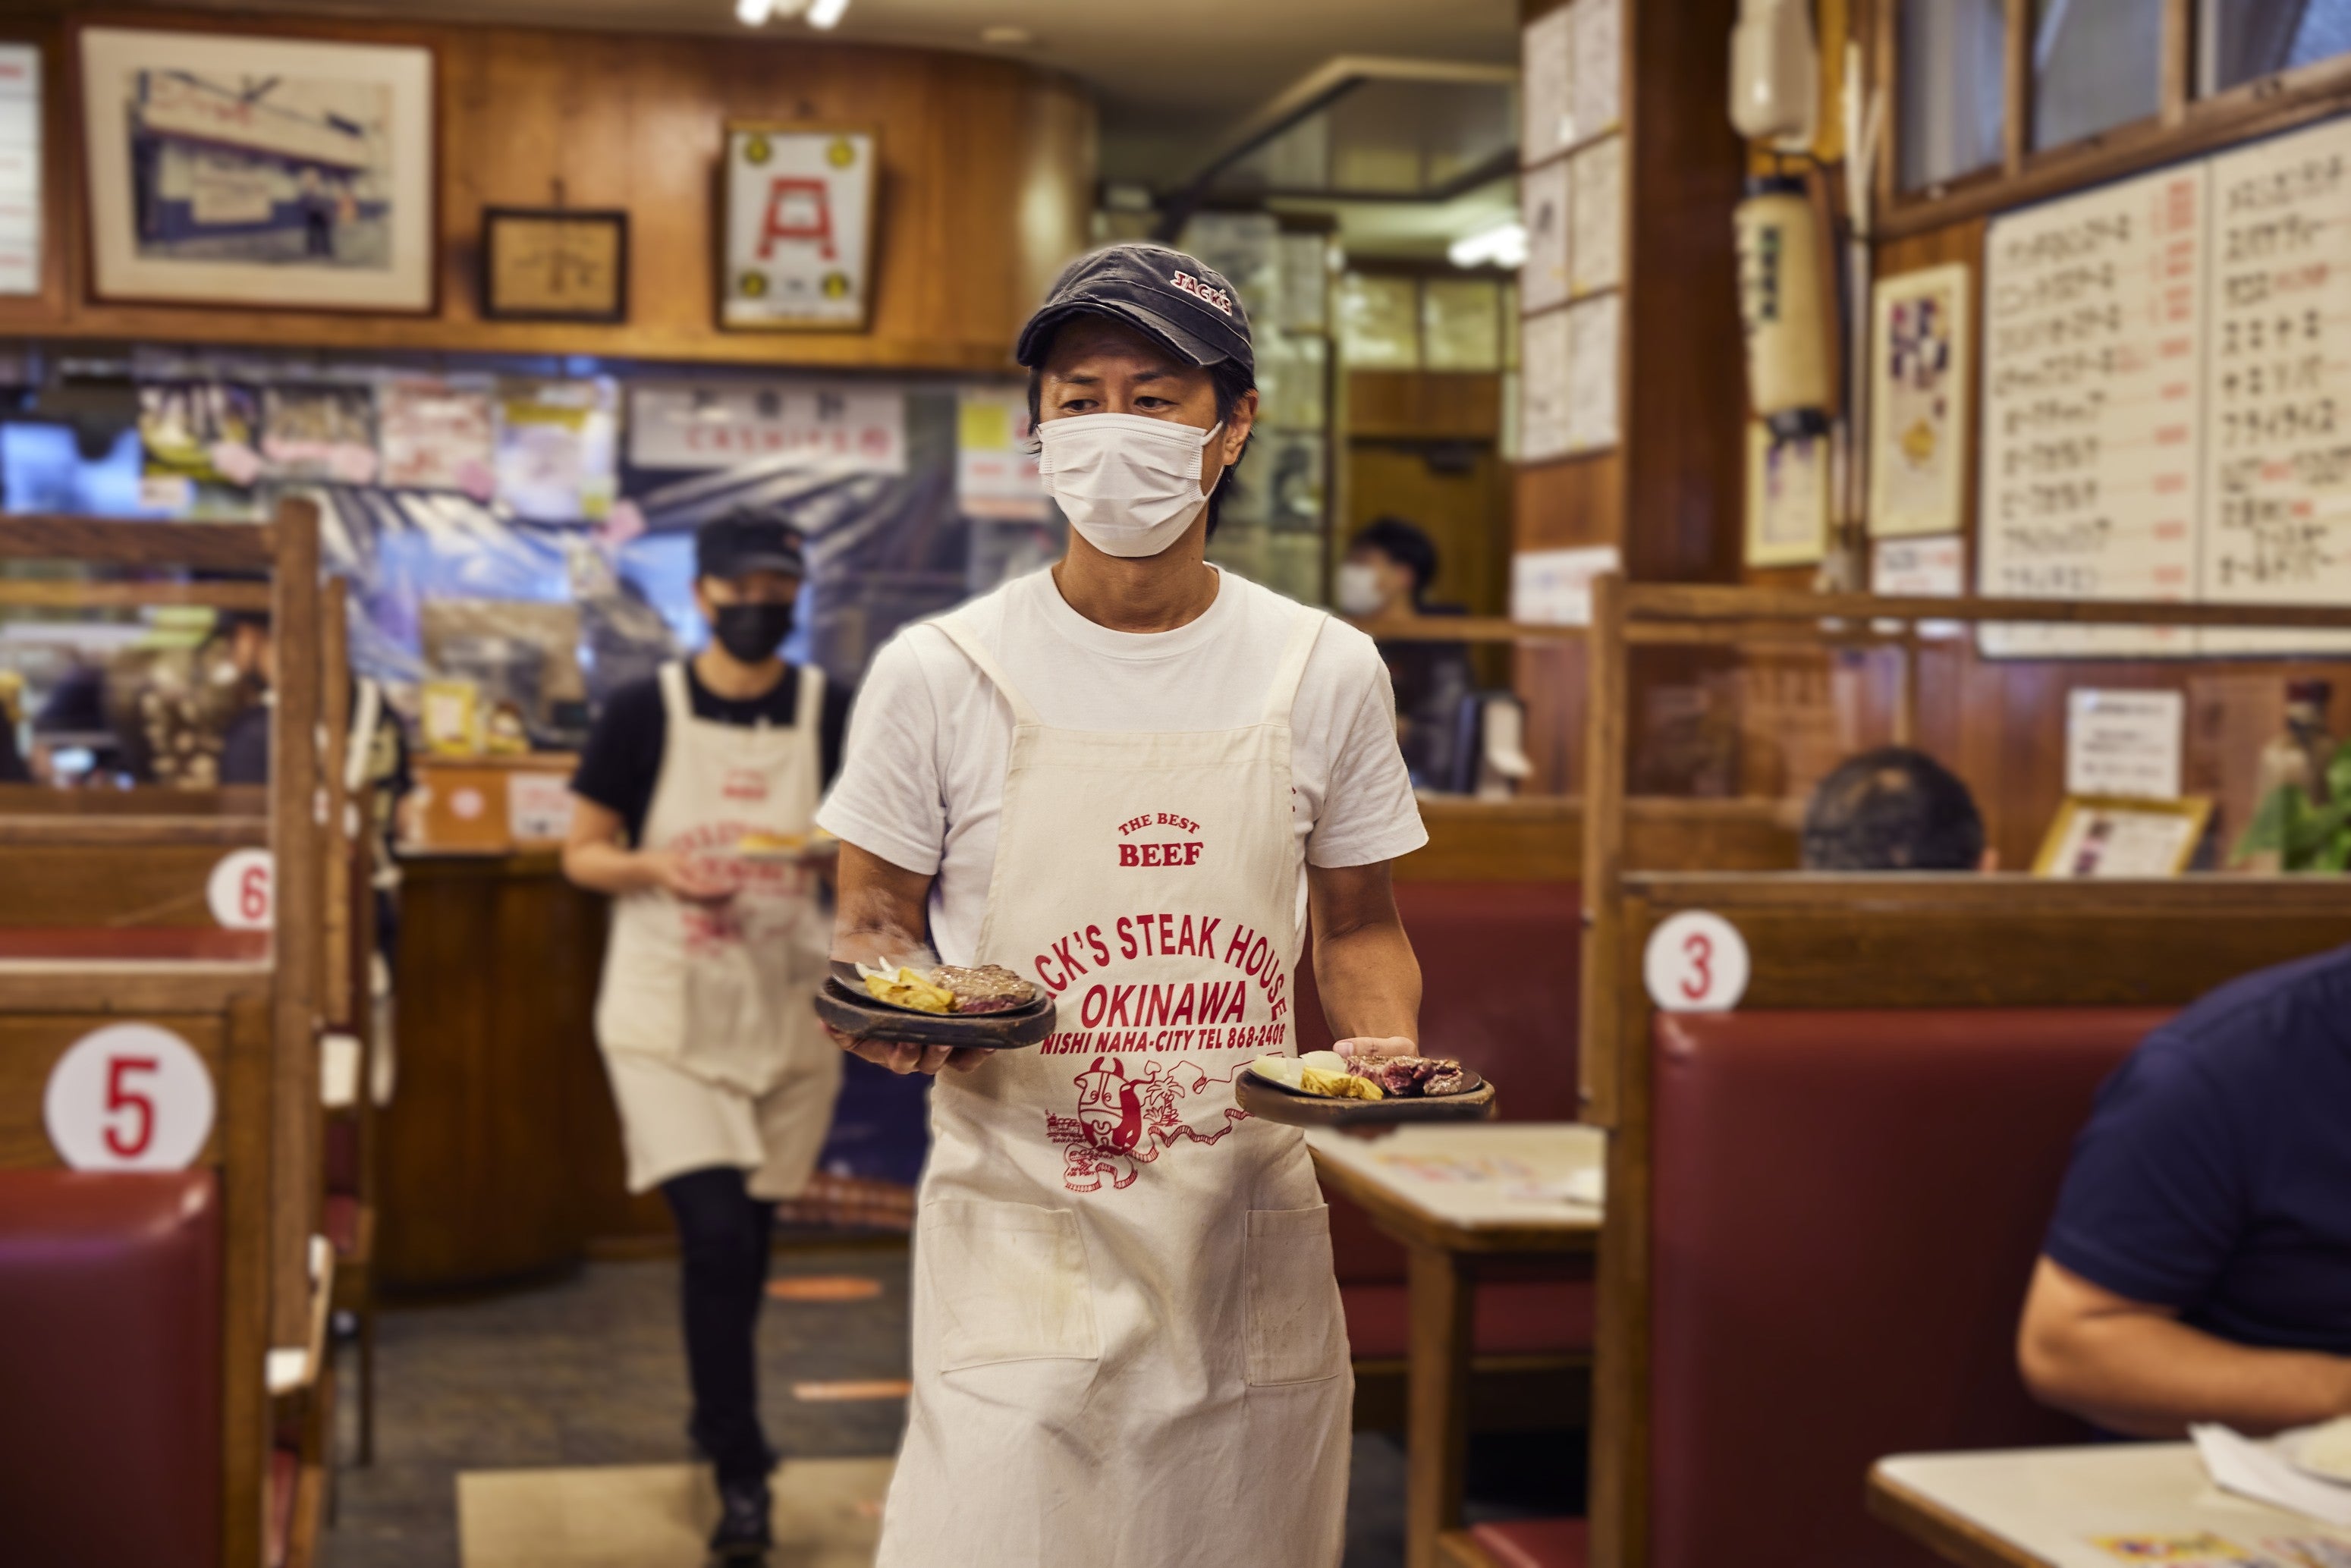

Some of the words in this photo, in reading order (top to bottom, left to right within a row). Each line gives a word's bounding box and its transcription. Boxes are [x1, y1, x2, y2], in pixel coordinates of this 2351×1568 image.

[1170, 270, 1232, 316] JACK'S
[1118, 814, 1152, 835] THE
[1157, 812, 1199, 834] BEST
[1118, 842, 1204, 866] BEEF
[240, 865, 268, 920] 6
[1035, 924, 1110, 1000] CK'S
[1116, 913, 1222, 960] STEAK
[1224, 924, 1287, 1022] HOUSE
[1680, 932, 1712, 1001] 3
[1081, 980, 1246, 1029] OKINAWA
[1040, 1032, 1092, 1054] NISHI
[1094, 1029, 1196, 1054] NAHA-CITY
[1198, 1028, 1223, 1051] TEL
[1227, 1023, 1287, 1048] 868-2408
[102, 1053, 160, 1160] 5
